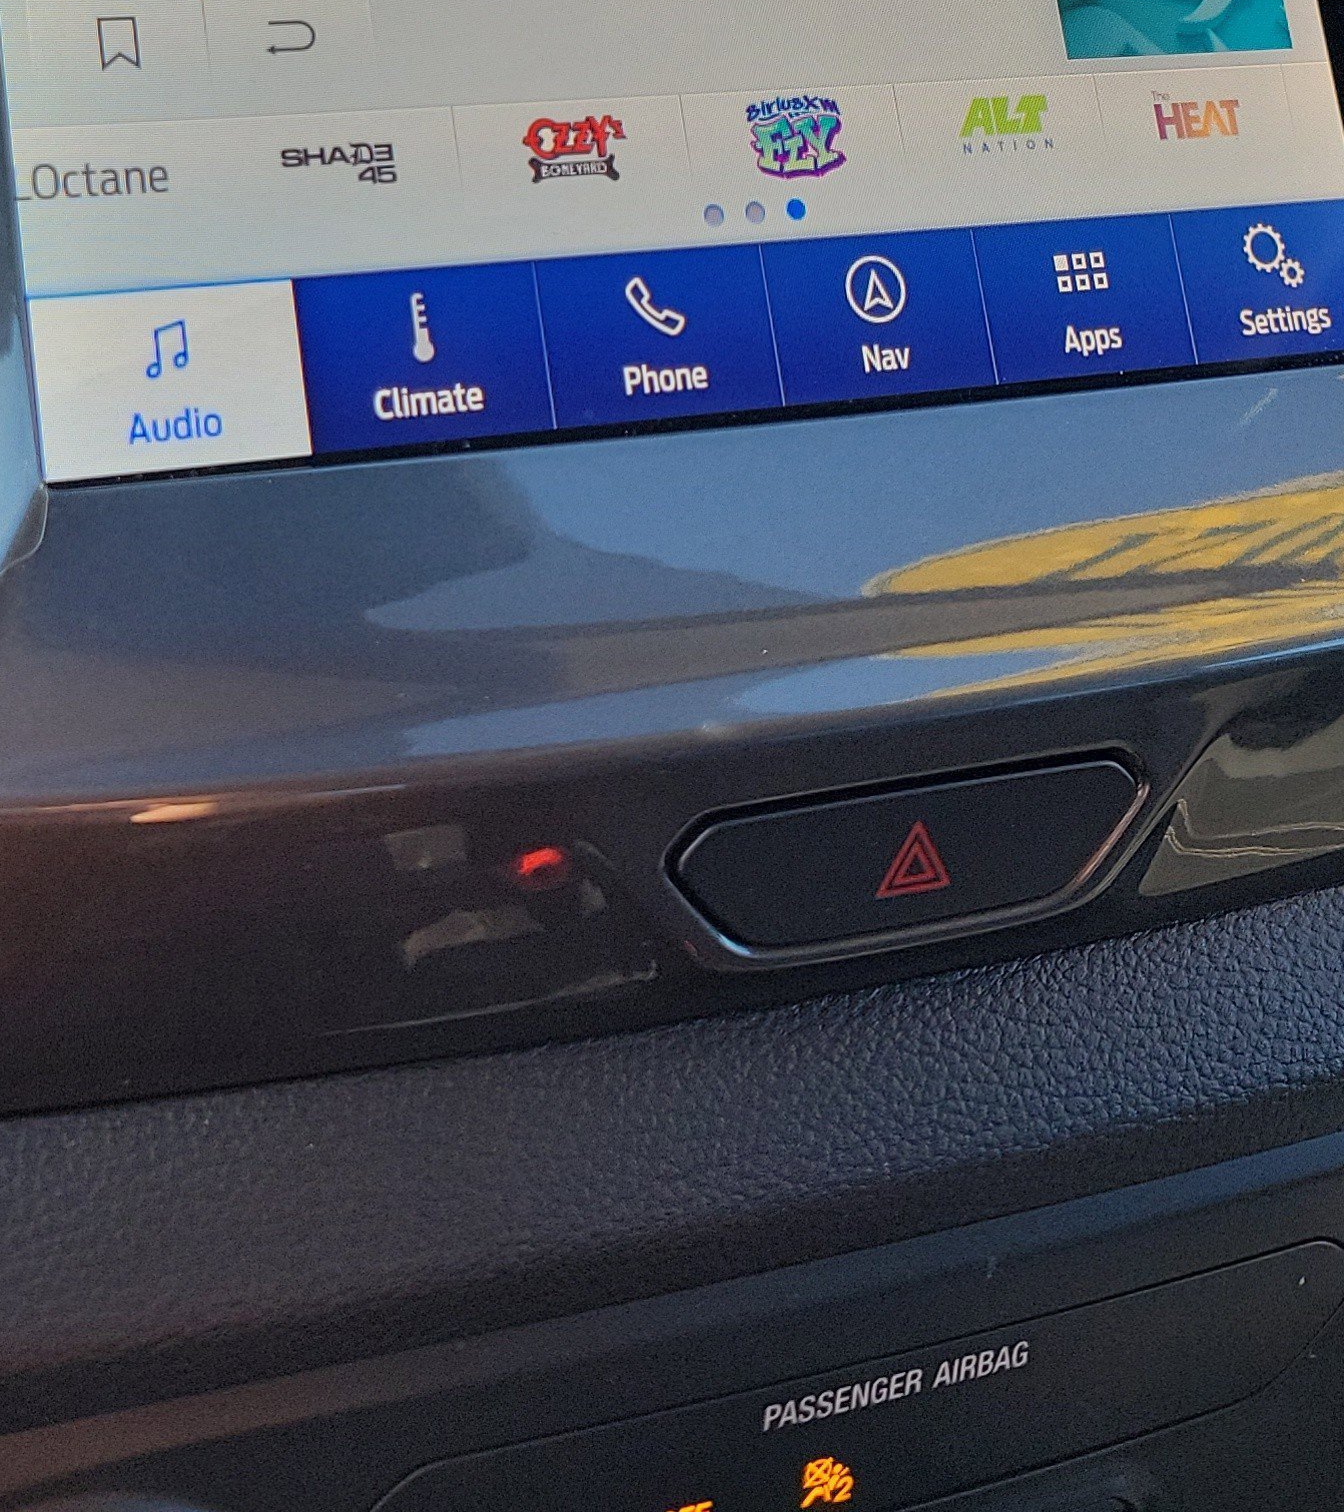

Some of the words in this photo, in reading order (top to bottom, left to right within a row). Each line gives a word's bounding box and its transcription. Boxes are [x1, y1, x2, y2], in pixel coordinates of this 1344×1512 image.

[958, 94, 1049, 137] ALT
[1153, 99, 1241, 141] HEAT
[750, 112, 847, 180] FLY
[962, 138, 1055, 155] NATION
[358, 165, 398, 185] 45
[1239, 306, 1333, 337] Settings
[1064, 325, 1123, 356] Apps
[862, 344, 911, 373] Nav
[623, 363, 709, 396] Phone
[373, 384, 485, 420] Climate
[128, 407, 224, 445] Audio
[762, 1368, 924, 1432] PASSENGER
[932, 1340, 1030, 1389] AIRBAG
